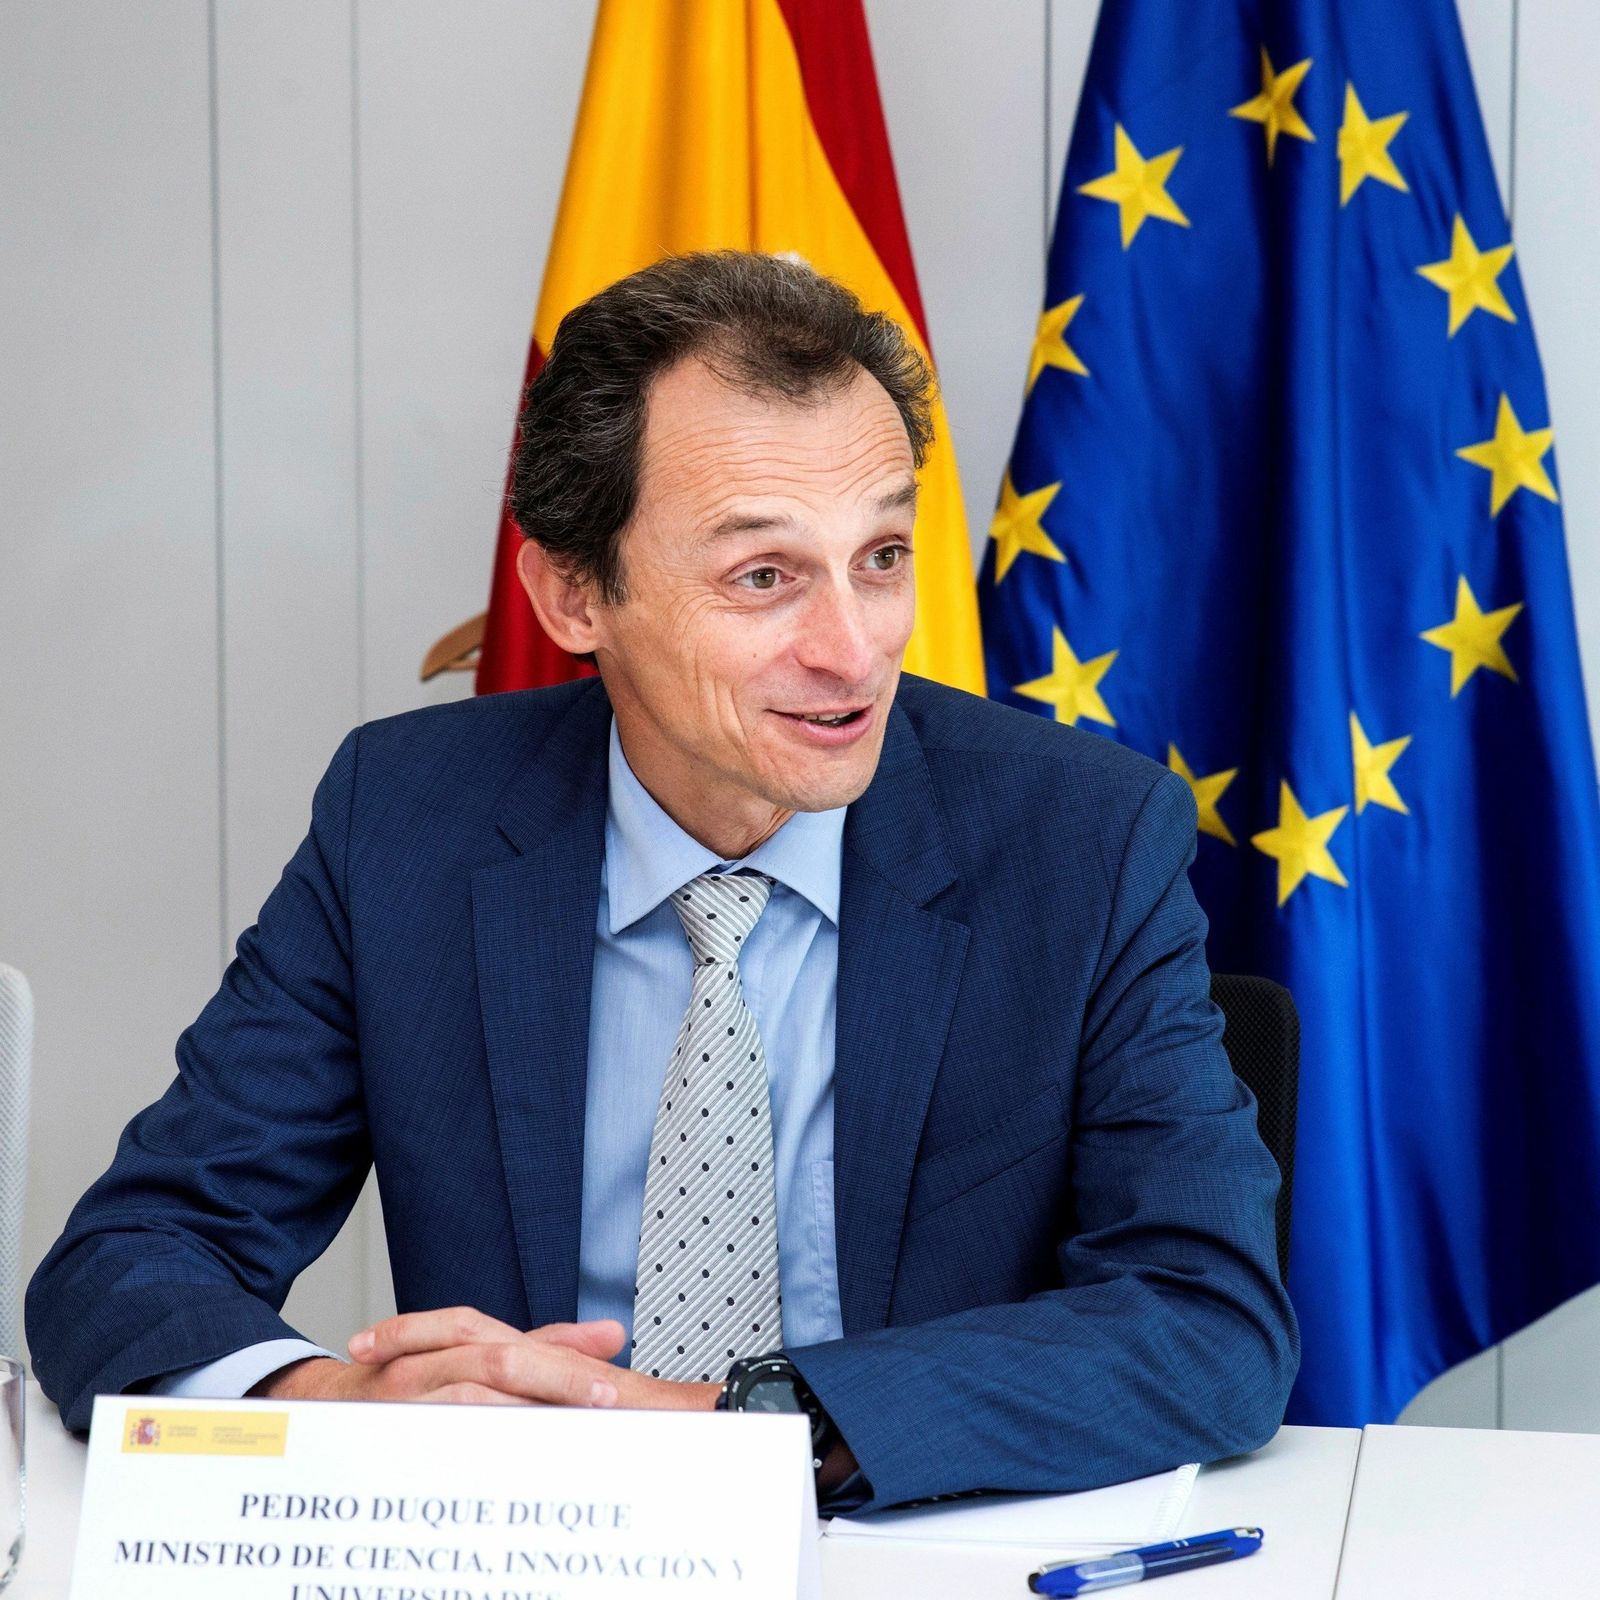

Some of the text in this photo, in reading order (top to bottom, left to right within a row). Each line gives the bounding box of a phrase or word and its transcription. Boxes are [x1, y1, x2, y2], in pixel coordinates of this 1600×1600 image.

[239, 1492, 631, 1532] PEDRO DUQUE DUQUE
[114, 1539, 748, 1581] MINISTRO DE CIENCIA, INNOVACIÓN Y
